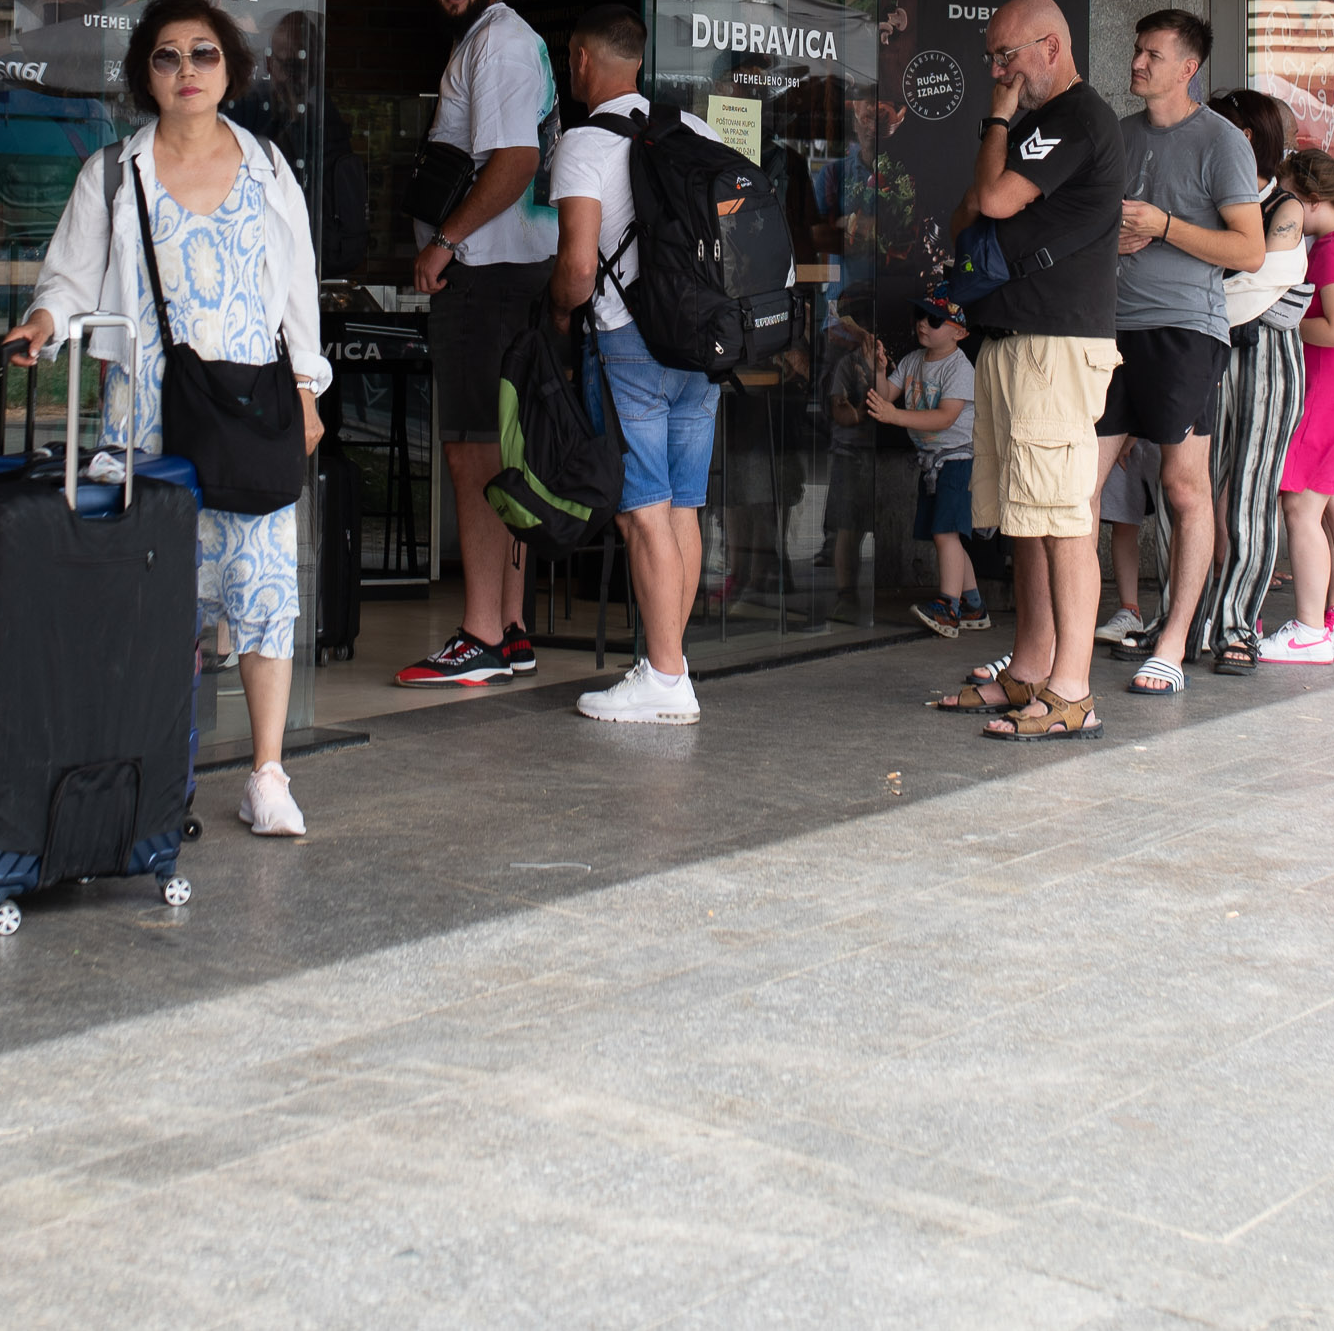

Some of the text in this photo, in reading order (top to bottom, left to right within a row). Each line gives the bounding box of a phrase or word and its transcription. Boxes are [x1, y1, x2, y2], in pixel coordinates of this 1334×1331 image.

[83, 14, 141, 31] UTEMEL
[692, 13, 838, 61] DUBRAVICA
[733, 72, 800, 88] UTEMELJENO 1961
[917, 72, 950, 87] RUČNA
[917, 84, 953, 98] IZRADA
